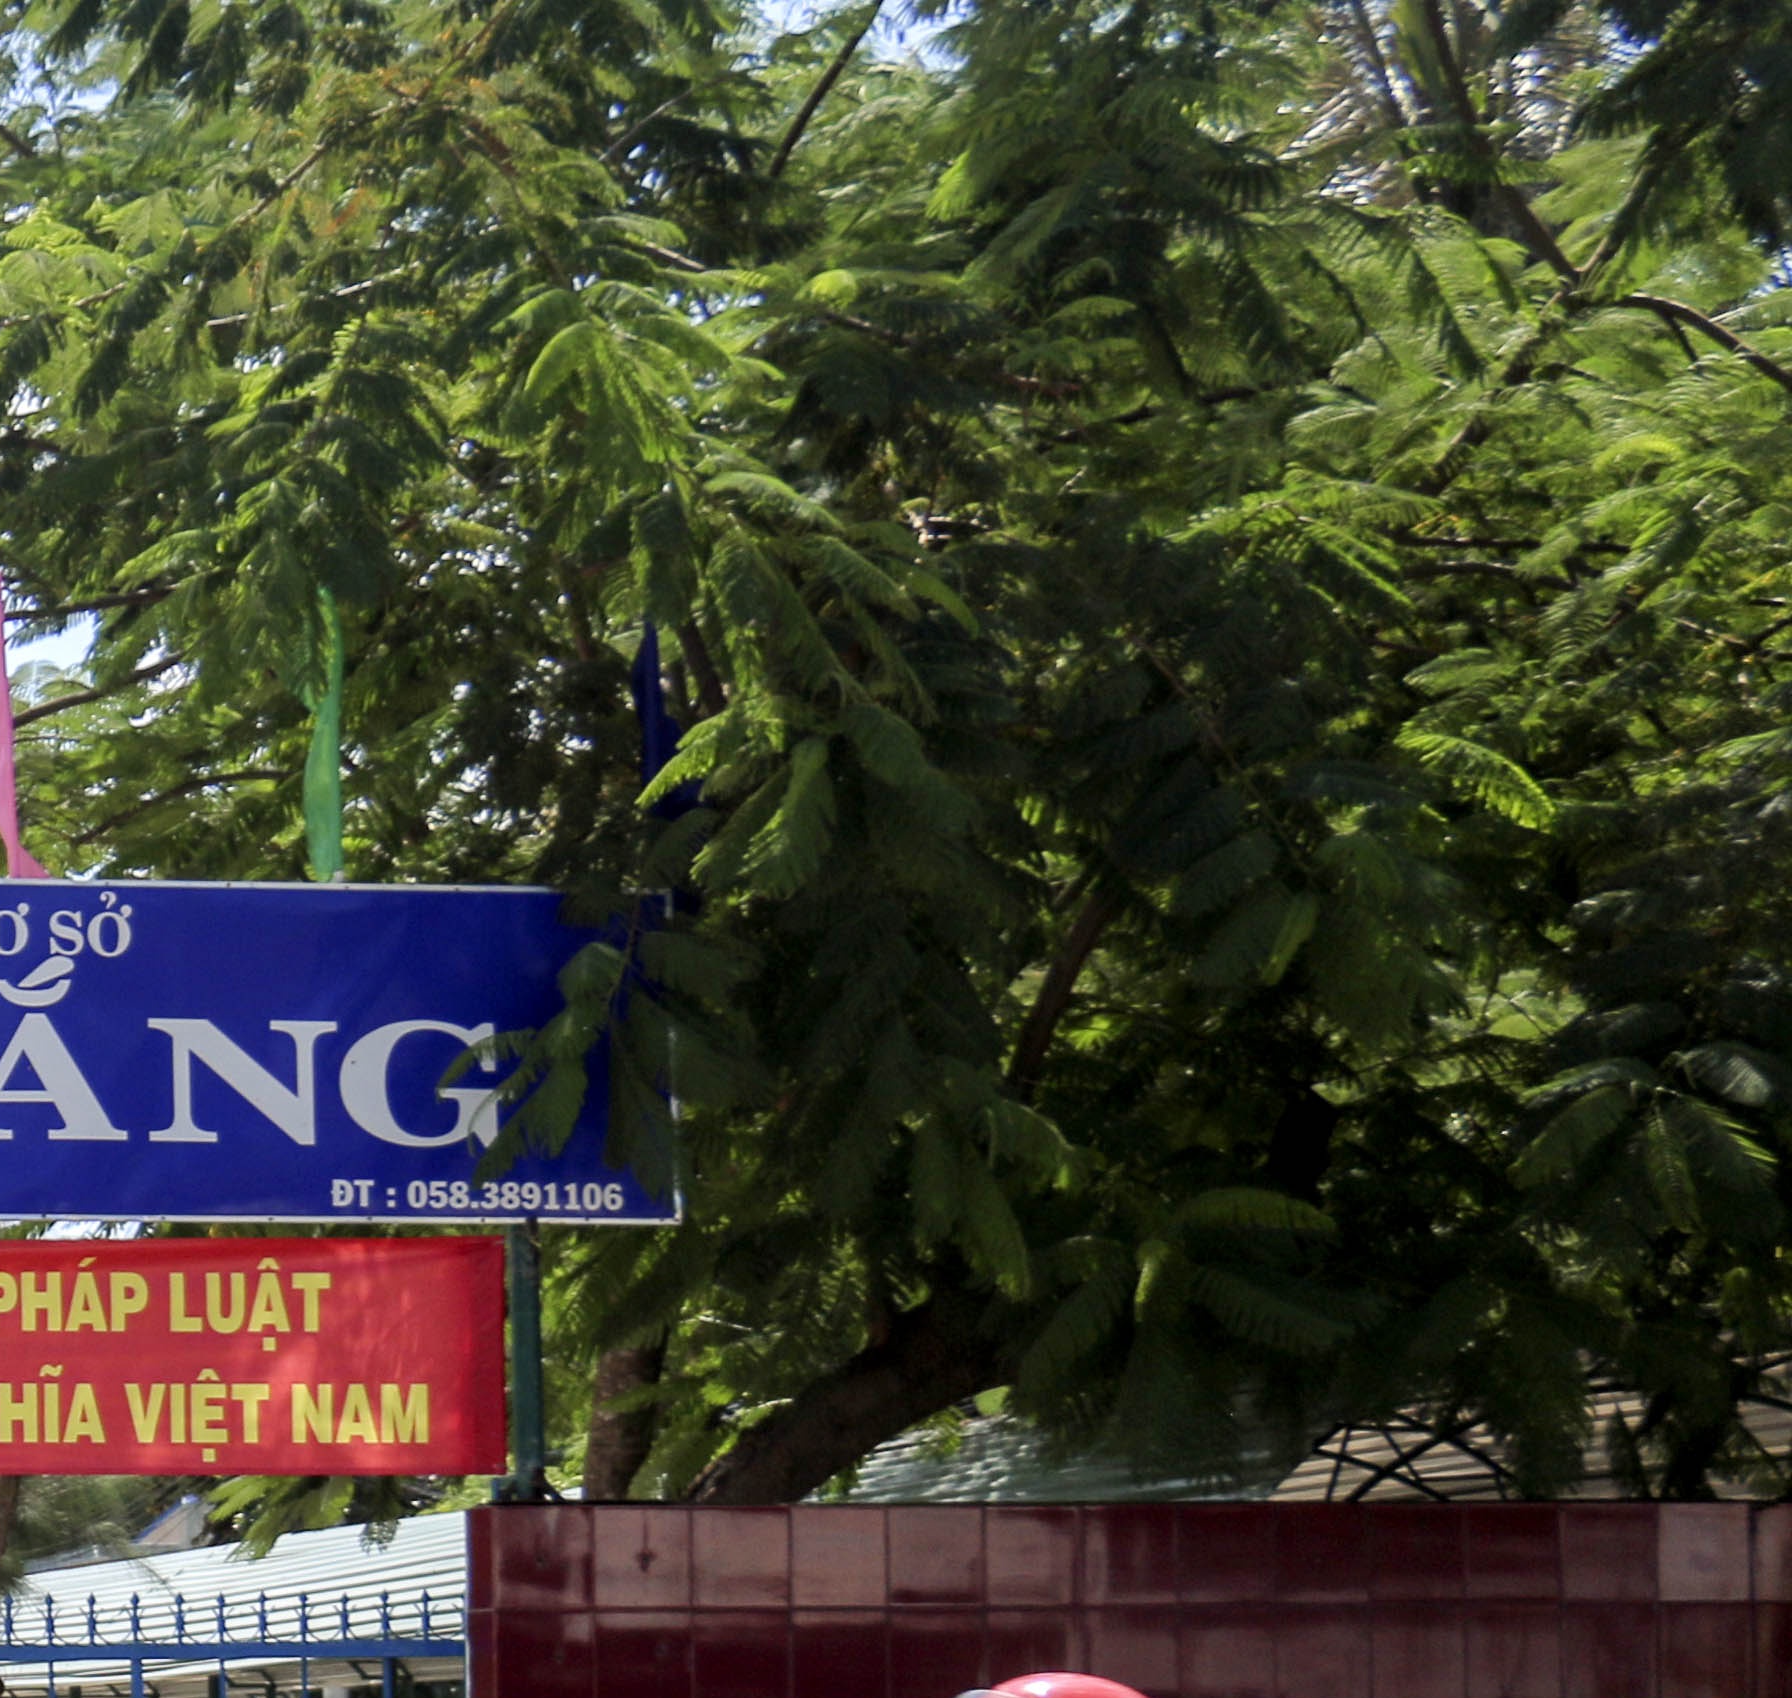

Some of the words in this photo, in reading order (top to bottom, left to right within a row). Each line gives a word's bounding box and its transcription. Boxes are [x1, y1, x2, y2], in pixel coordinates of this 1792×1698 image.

[49, 891, 133, 957] SỞ
[331, 1179, 374, 1207] ĐT
[407, 1180, 624, 1211] 058.3891106
[169, 1257, 331, 1351] LUẬT
[124, 1368, 269, 1463] VIỆT
[290, 1383, 430, 1444] NAM
